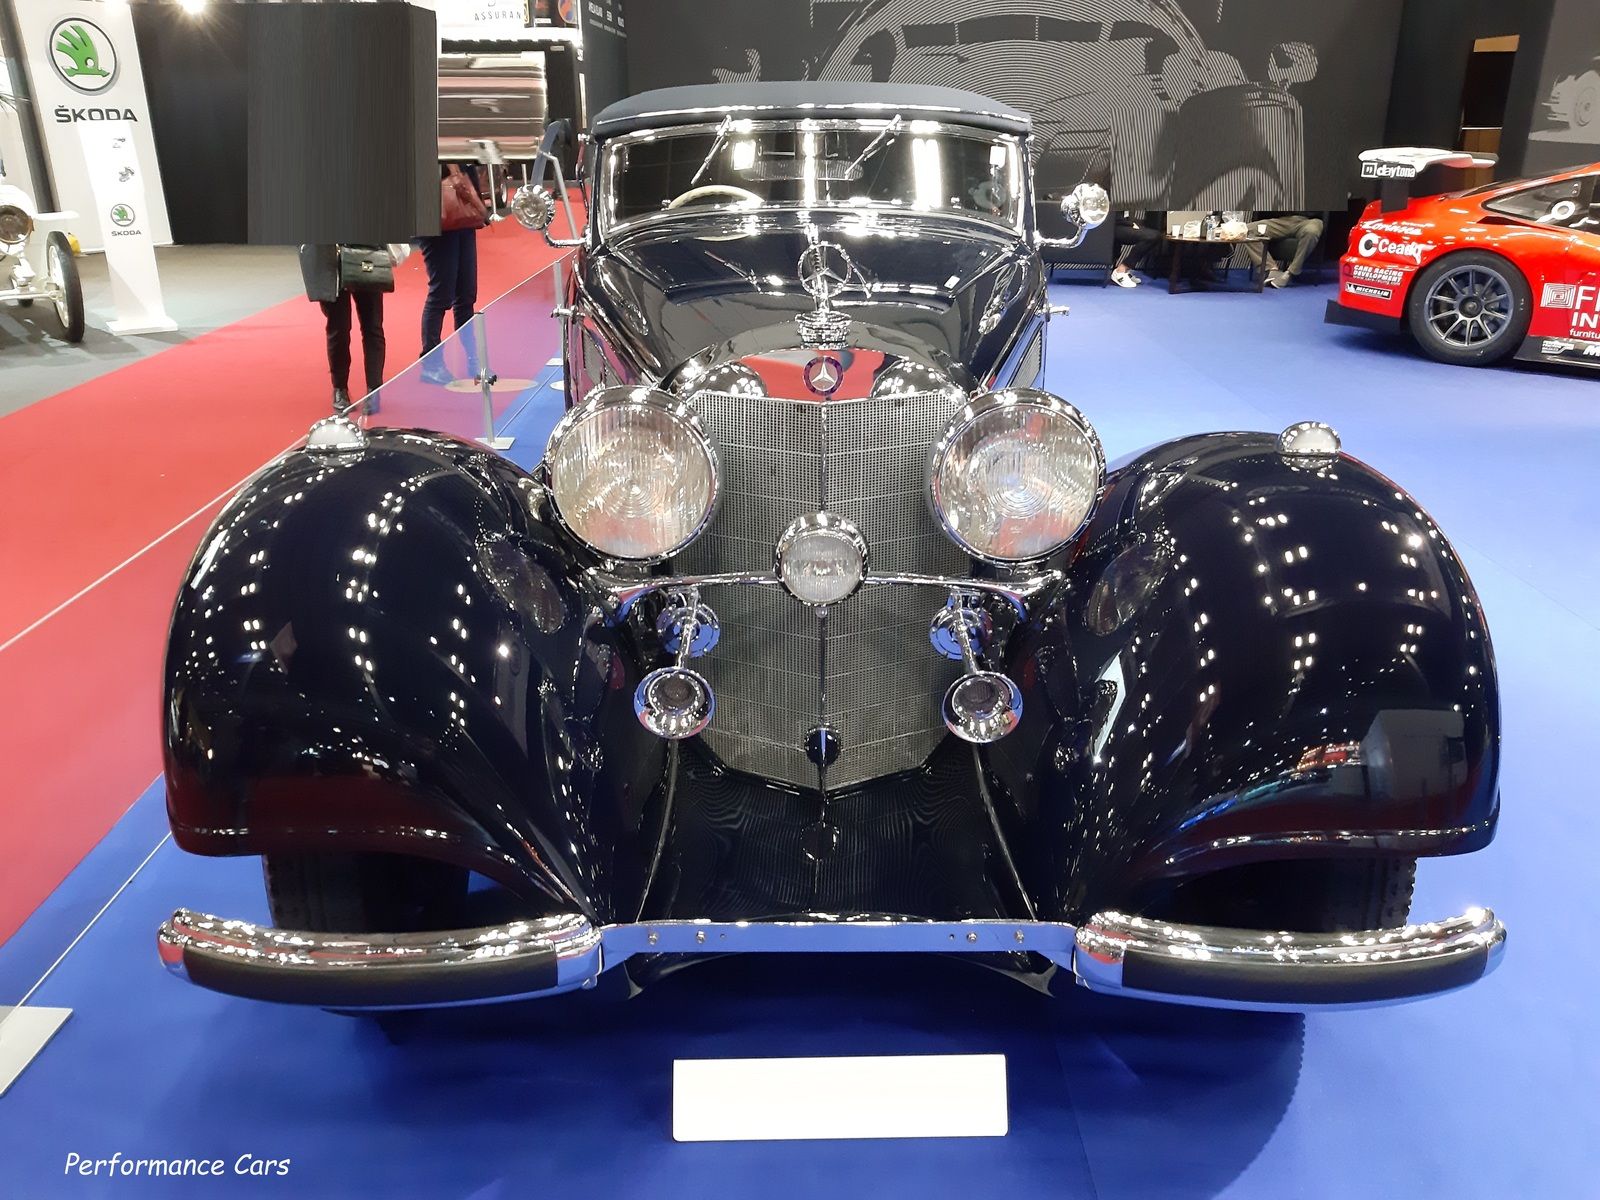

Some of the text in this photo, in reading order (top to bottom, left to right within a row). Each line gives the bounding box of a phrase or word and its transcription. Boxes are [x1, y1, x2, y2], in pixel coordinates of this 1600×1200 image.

[54, 105, 138, 123] ŠKODA
[1377, 164, 1416, 178] daytona
[1356, 286, 1390, 296] MICHELIN
[1571, 311, 1600, 329] IN
